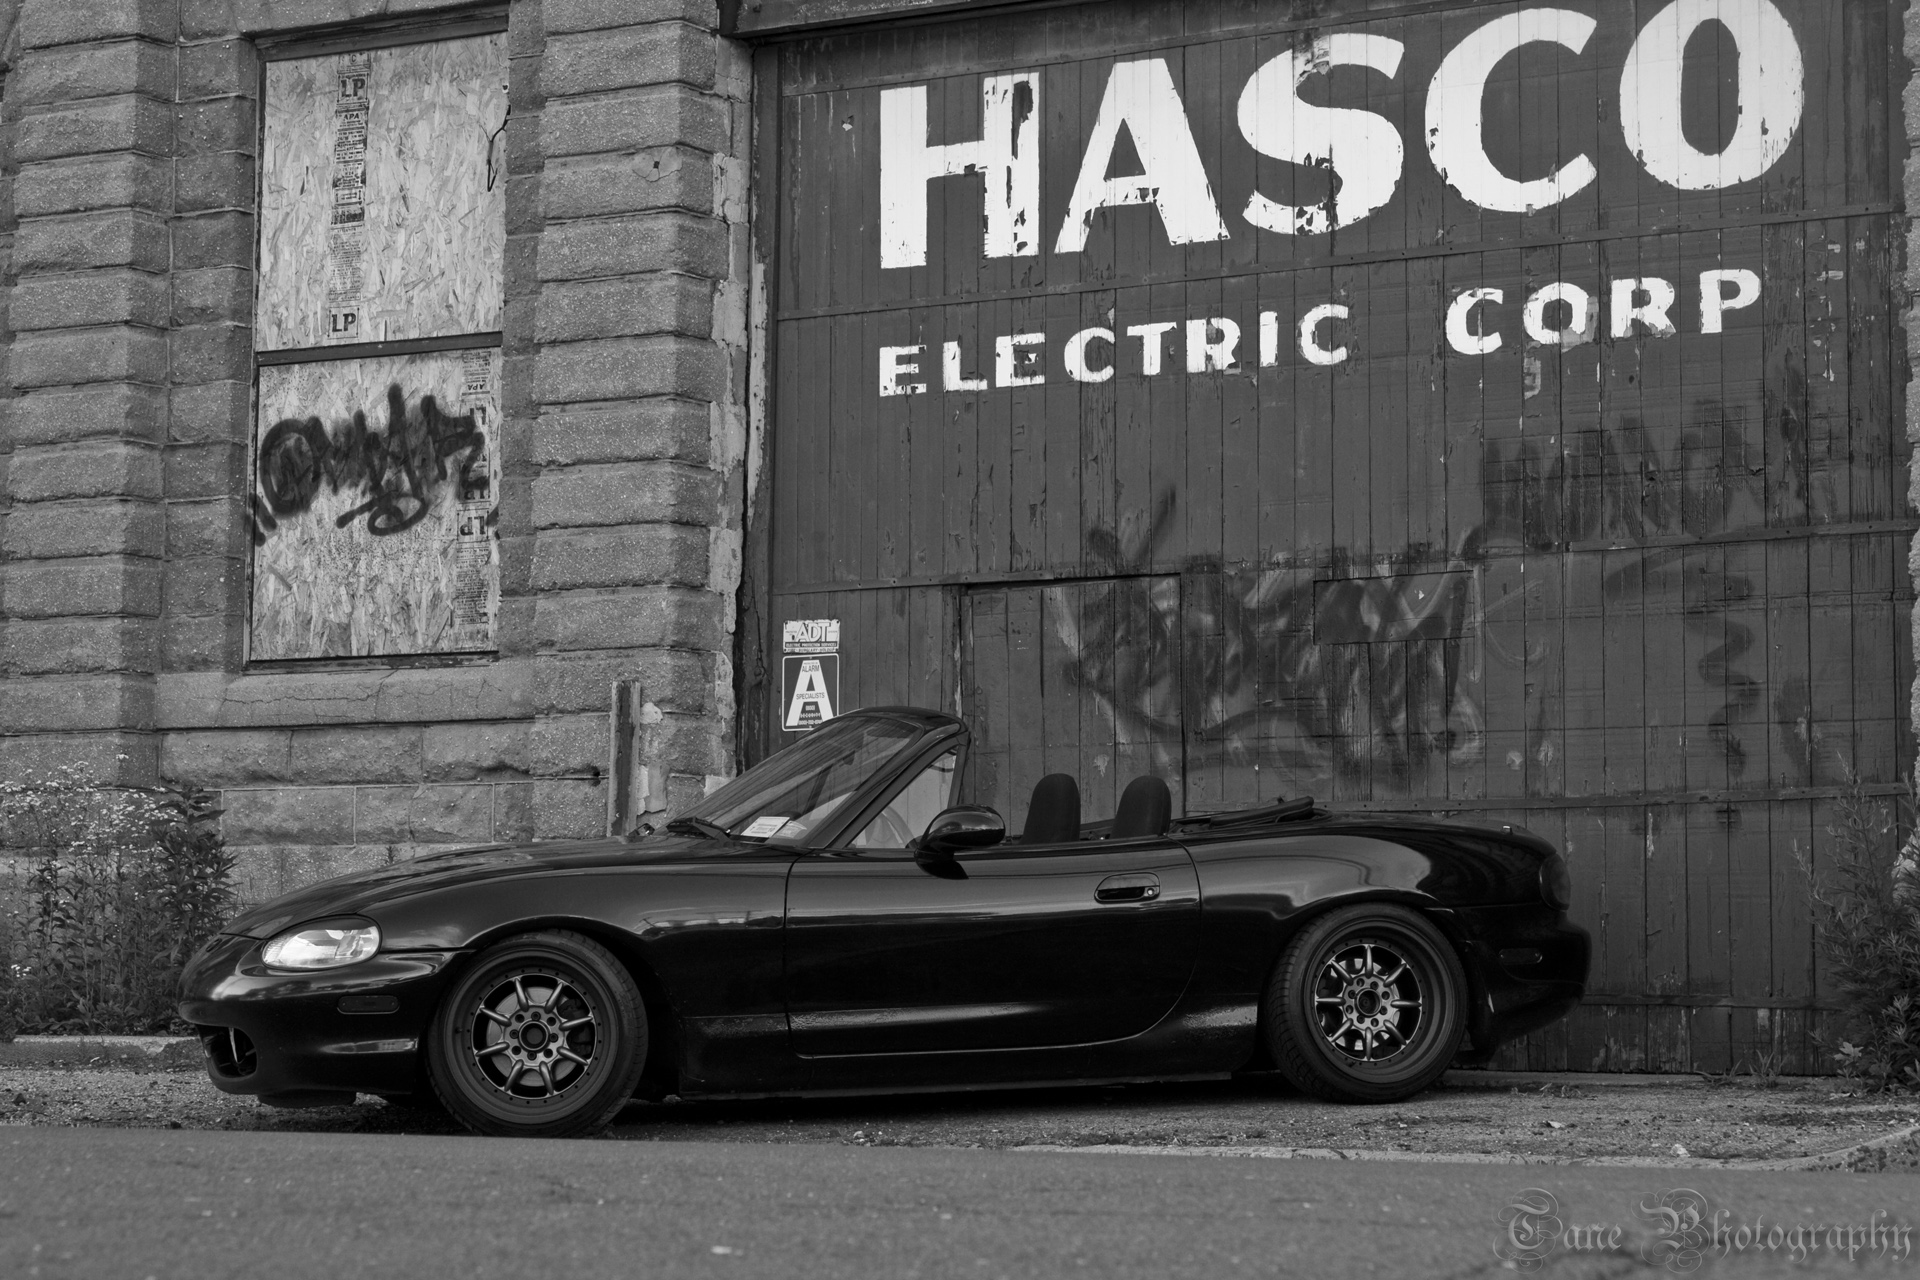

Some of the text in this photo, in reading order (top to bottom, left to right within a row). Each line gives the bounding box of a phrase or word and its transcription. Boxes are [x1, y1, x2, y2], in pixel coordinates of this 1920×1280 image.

[341, 78, 365, 97] LP
[880, 0, 1804, 270] HASCO
[331, 313, 356, 332] LP
[879, 269, 1761, 397] ELECTRIC CORP
[460, 516, 486, 535] LP
[795, 622, 831, 642] ADT
[796, 692, 825, 700] SPECIALISTS
